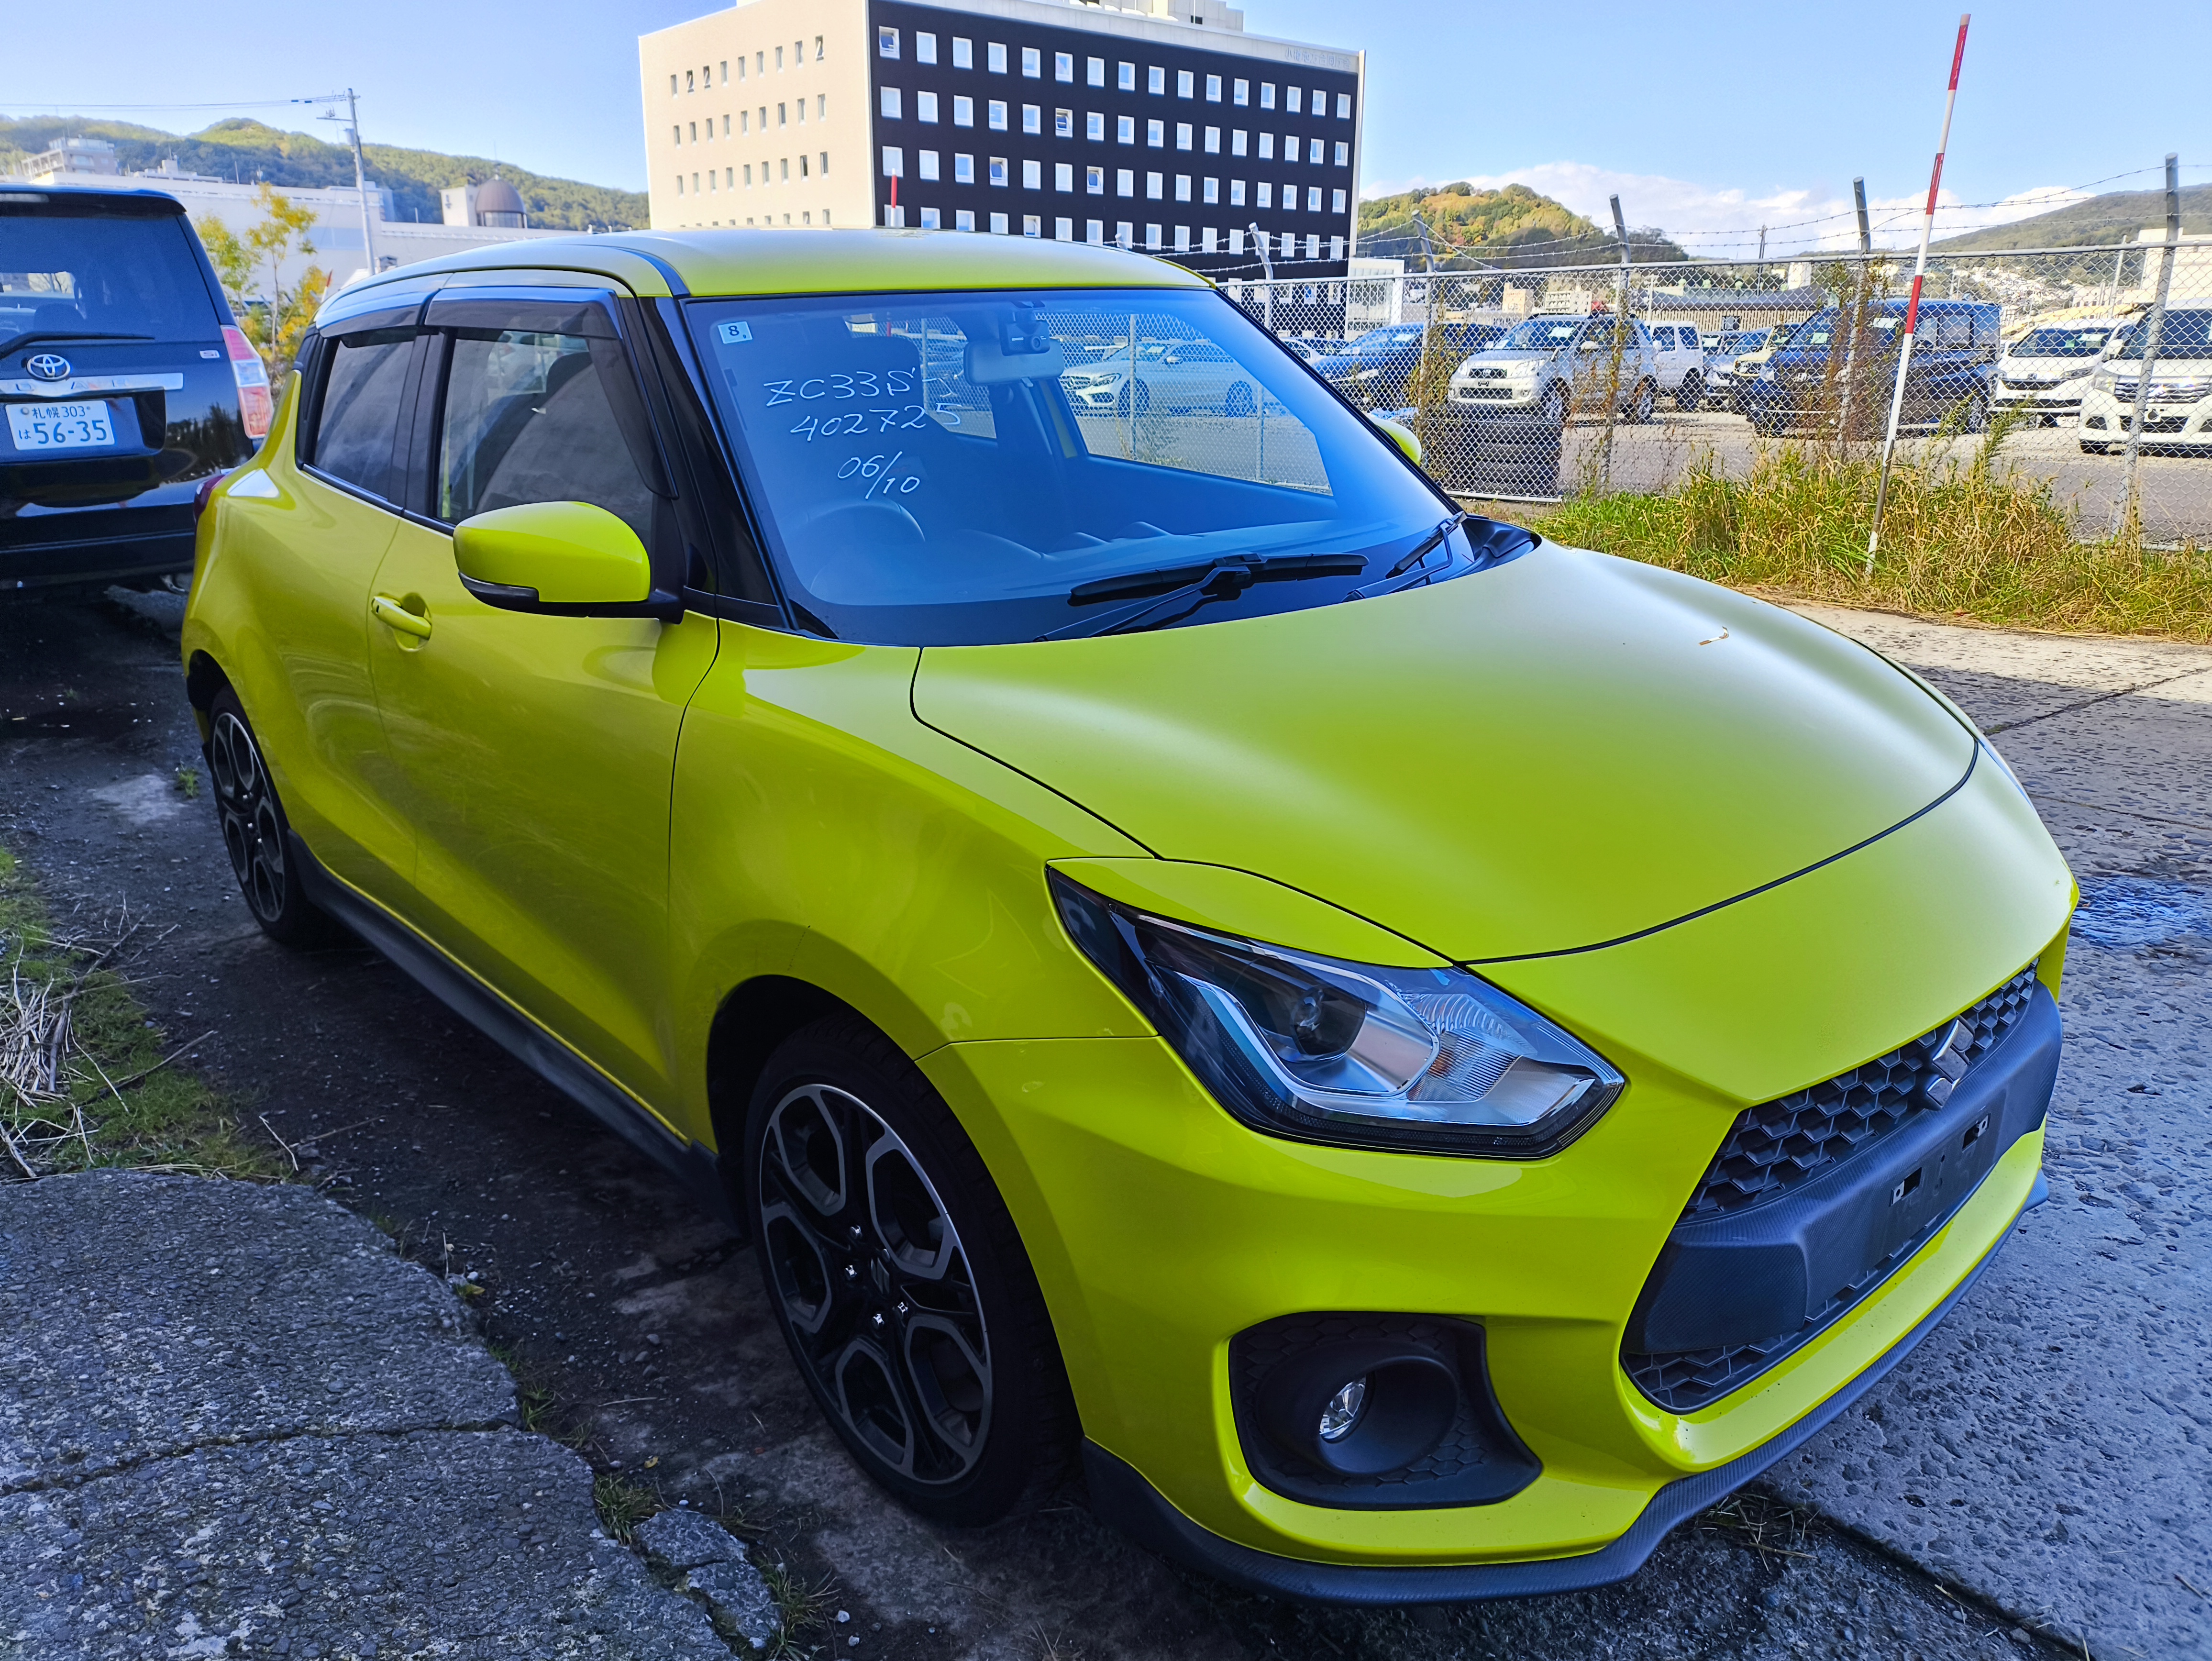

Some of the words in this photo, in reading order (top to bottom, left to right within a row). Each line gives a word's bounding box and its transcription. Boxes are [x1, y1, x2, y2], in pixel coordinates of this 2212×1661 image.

[728, 325, 740, 336] 8
[33, 420, 107, 444] 56-35
[791, 403, 962, 441] 402725
[838, 451, 920, 499] 06/10
